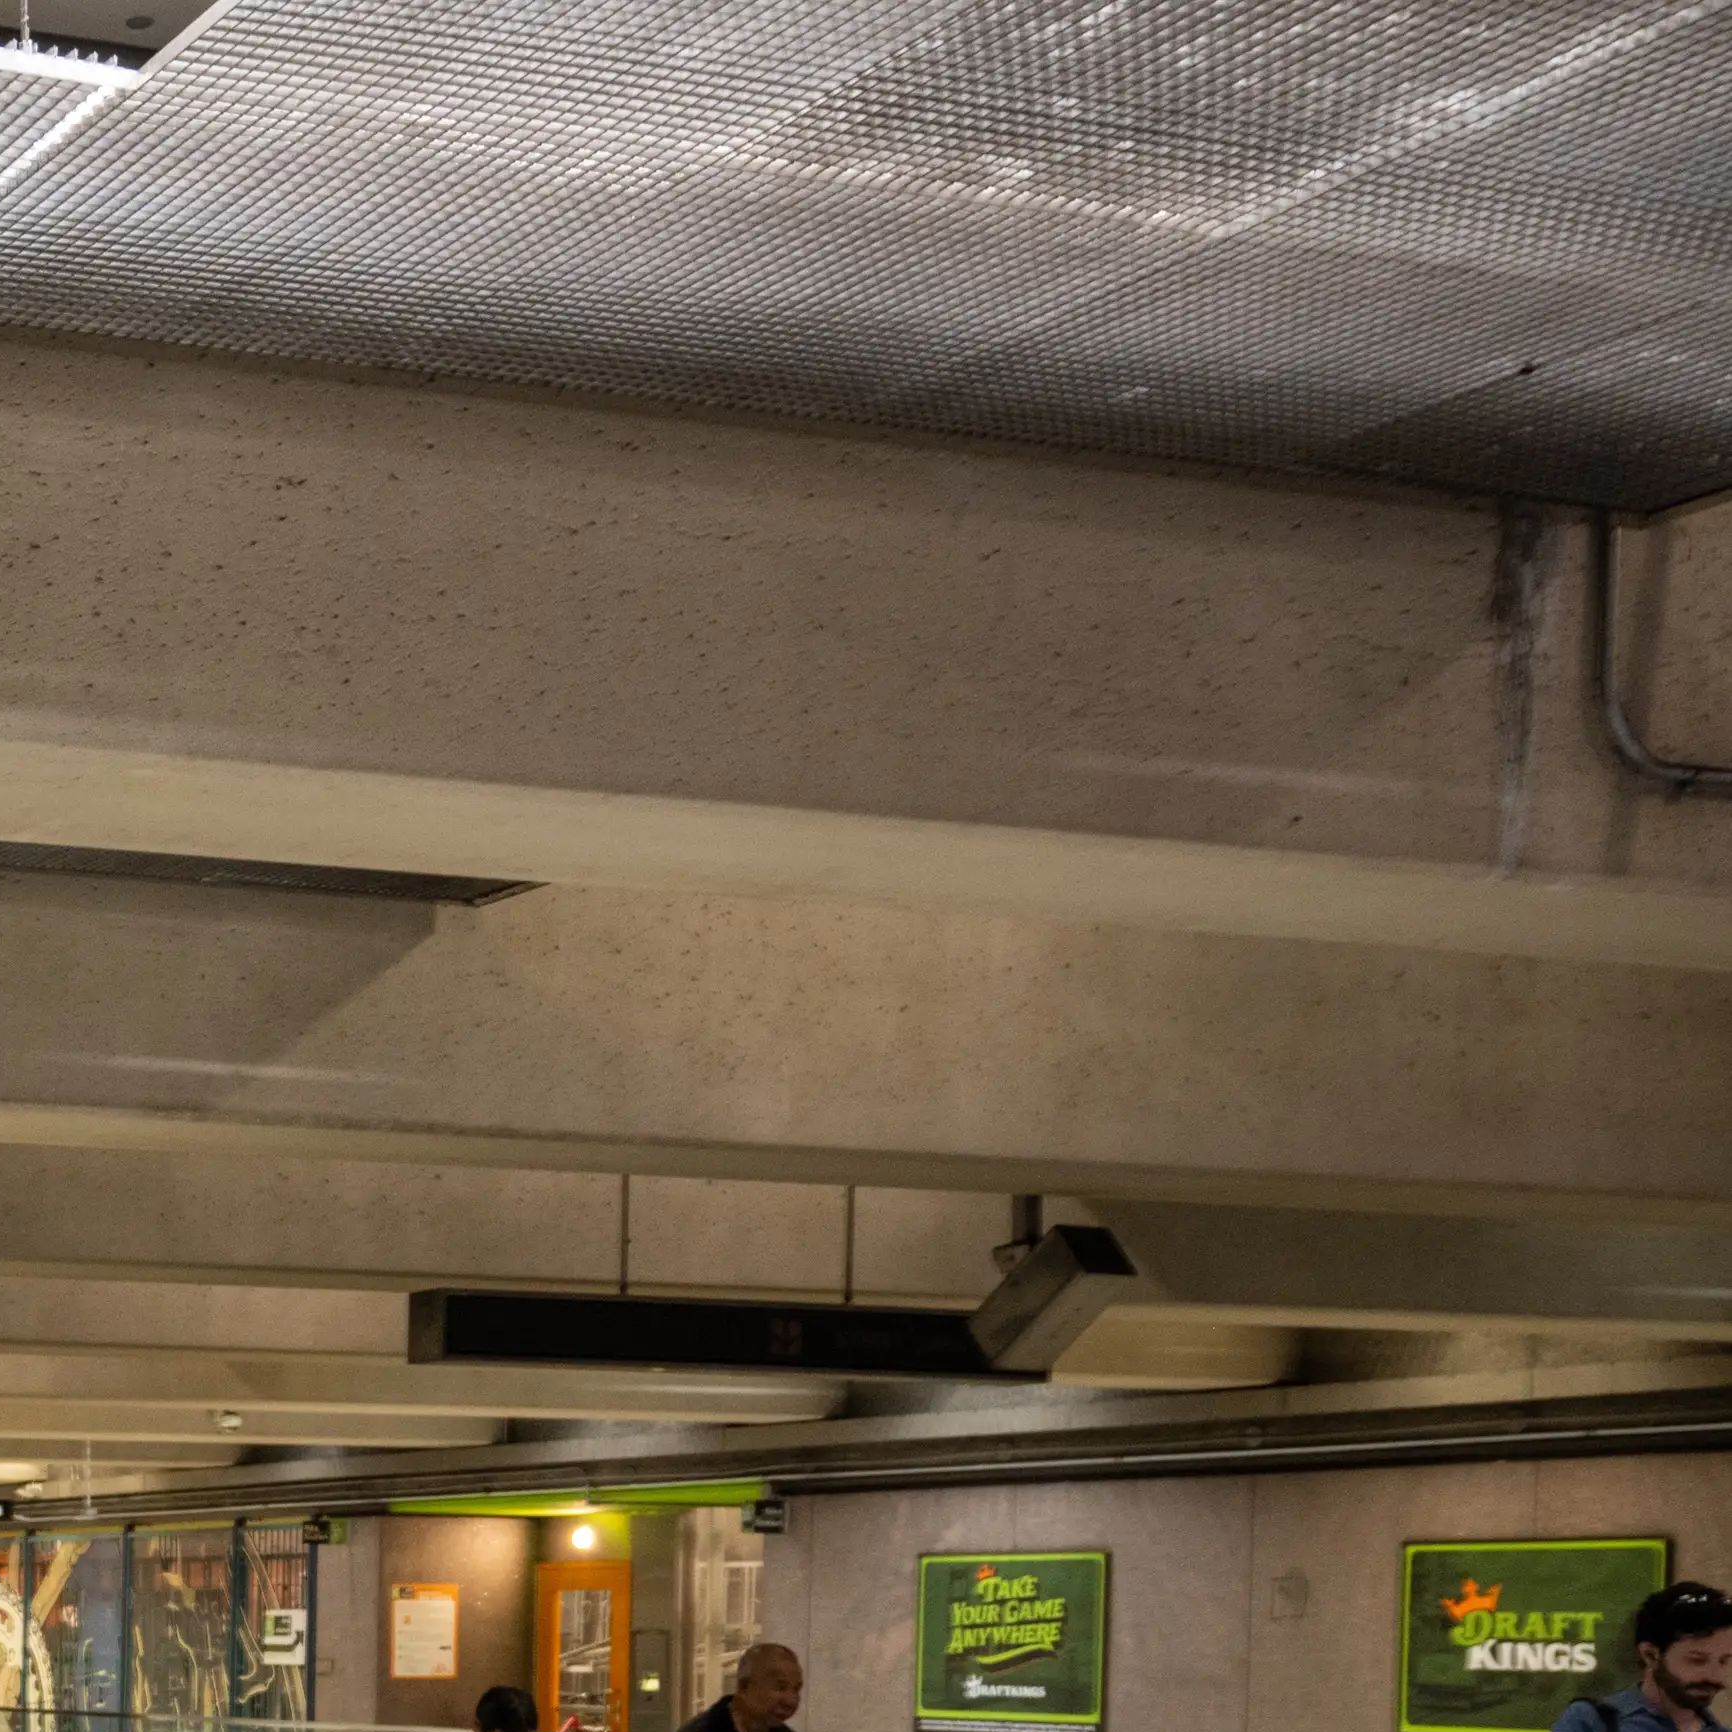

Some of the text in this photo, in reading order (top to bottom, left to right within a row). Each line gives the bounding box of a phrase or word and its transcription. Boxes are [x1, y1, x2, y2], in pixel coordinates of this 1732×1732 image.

[973, 1574, 1039, 1602] TAKE
[951, 1598, 1065, 1627] YOUR GAME
[1449, 1609, 1604, 1646] DRAFT
[945, 1622, 1063, 1655] ANYWHERE
[1464, 1638, 1598, 1673] KINGS
[963, 1681, 1047, 1699] DRAFTKINGS
